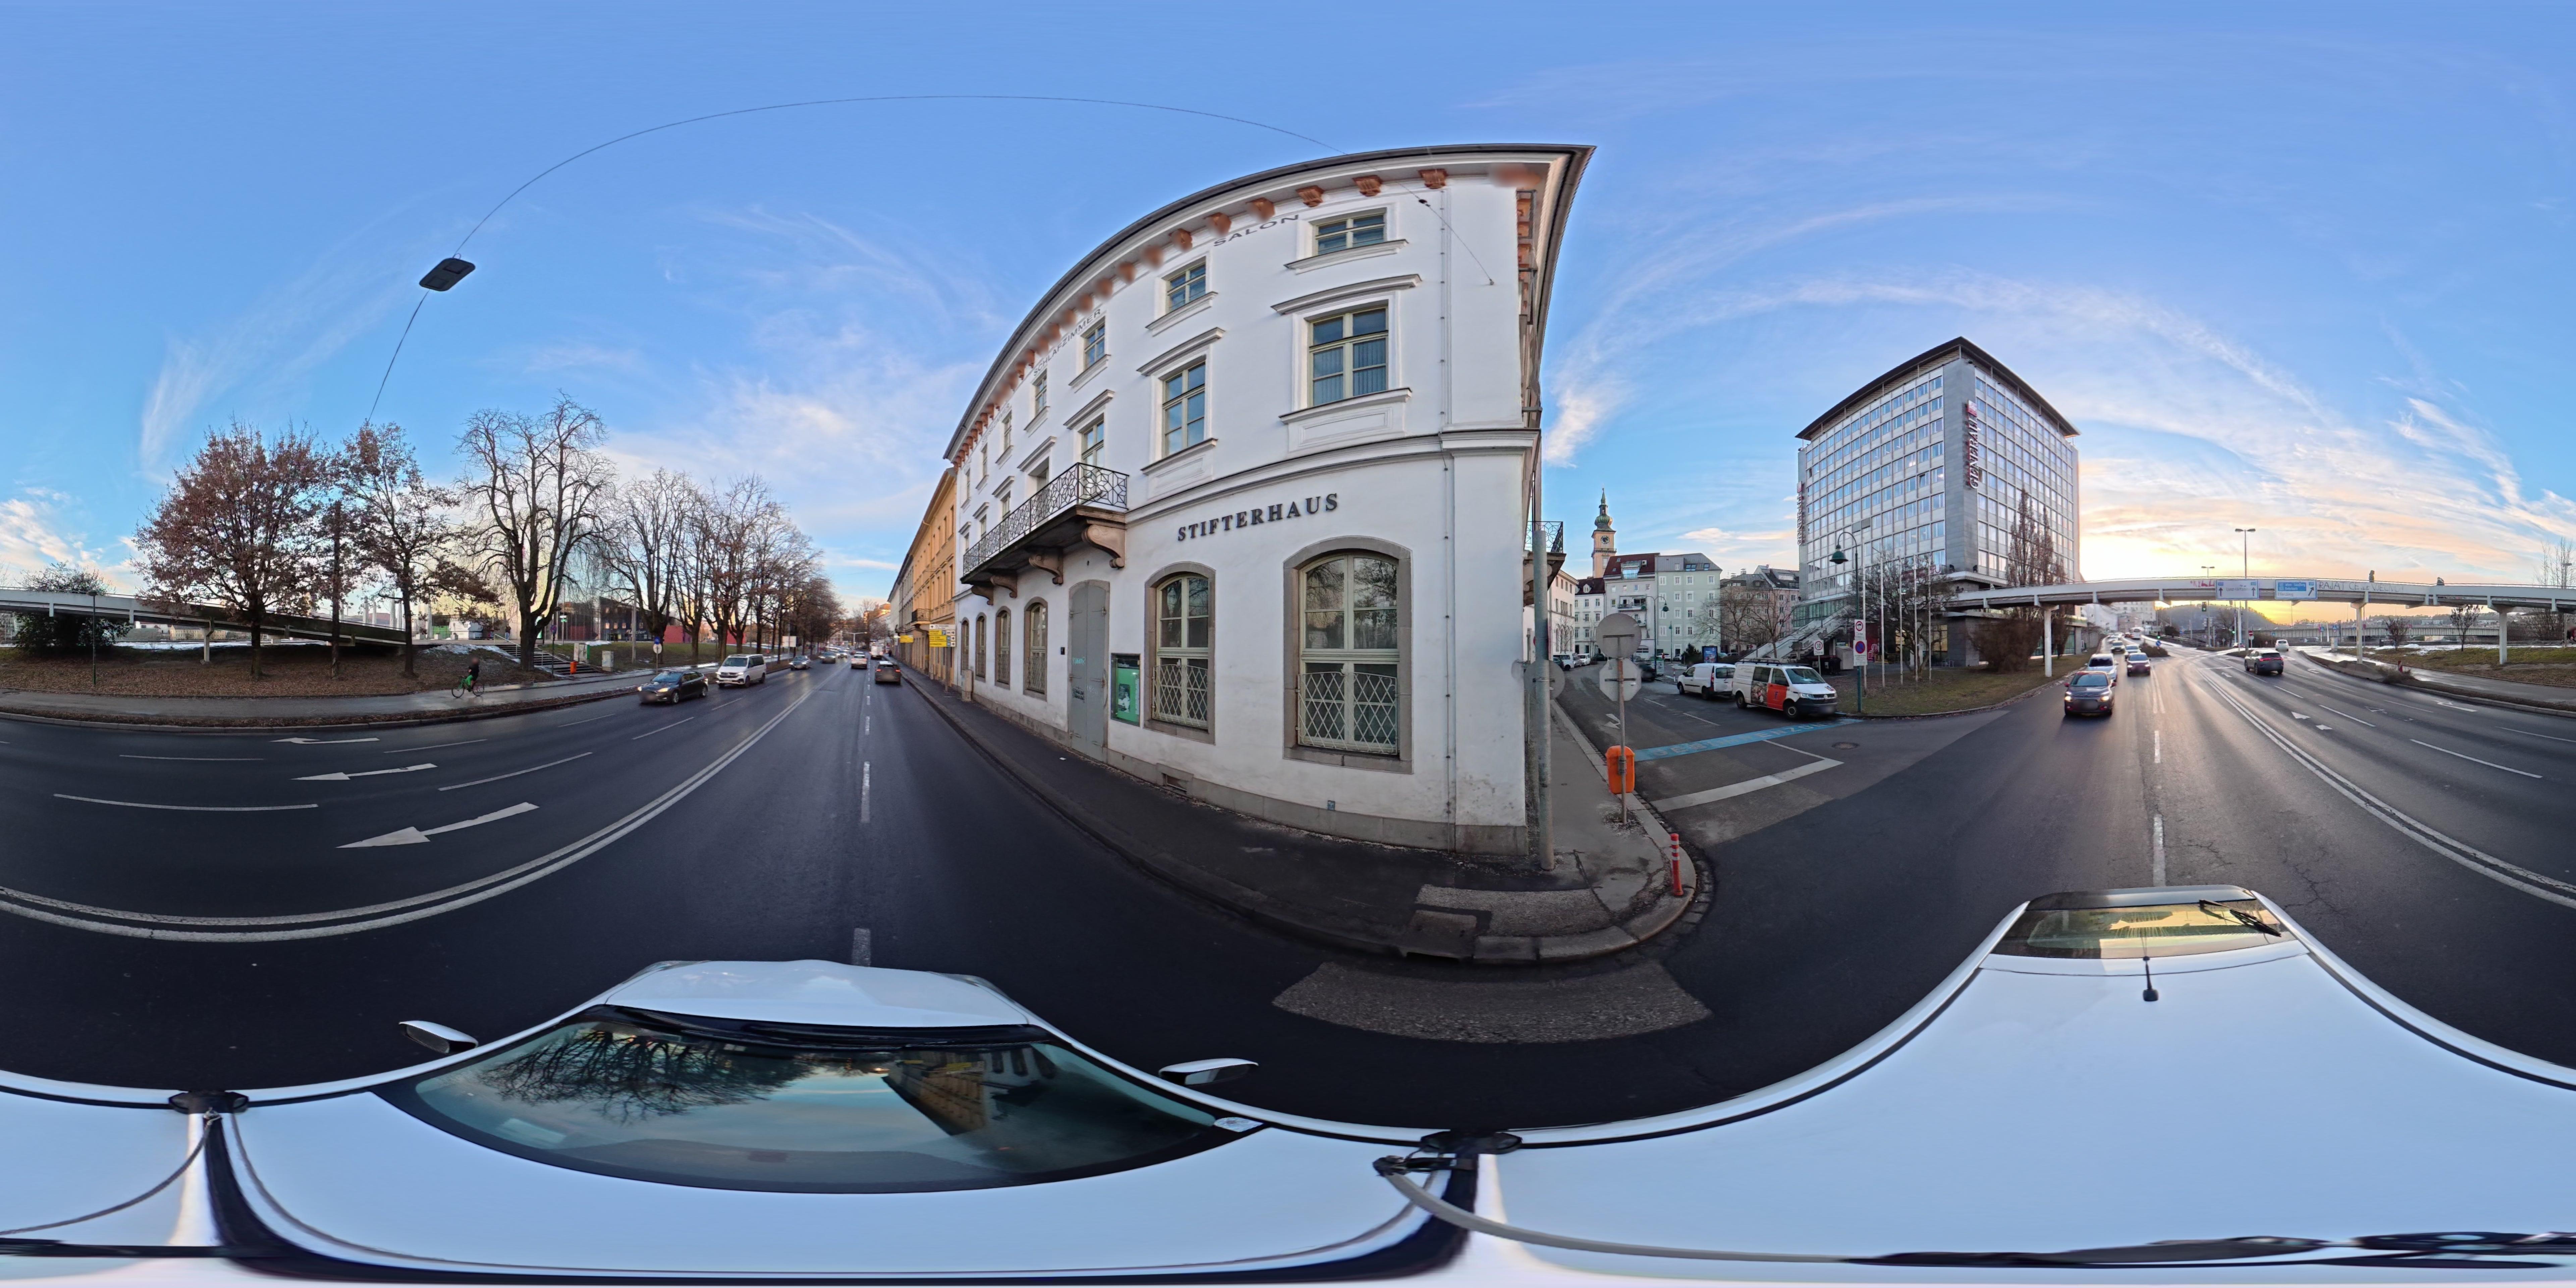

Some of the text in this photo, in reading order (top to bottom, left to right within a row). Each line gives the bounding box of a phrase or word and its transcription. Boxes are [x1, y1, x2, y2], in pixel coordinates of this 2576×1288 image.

[1213, 214, 1299, 247] SALON
[1033, 308, 1101, 376] SCHLAFZIMMER
[1968, 415, 1979, 489] GENERALI
[1178, 493, 1339, 541] STIFTERHAUS
